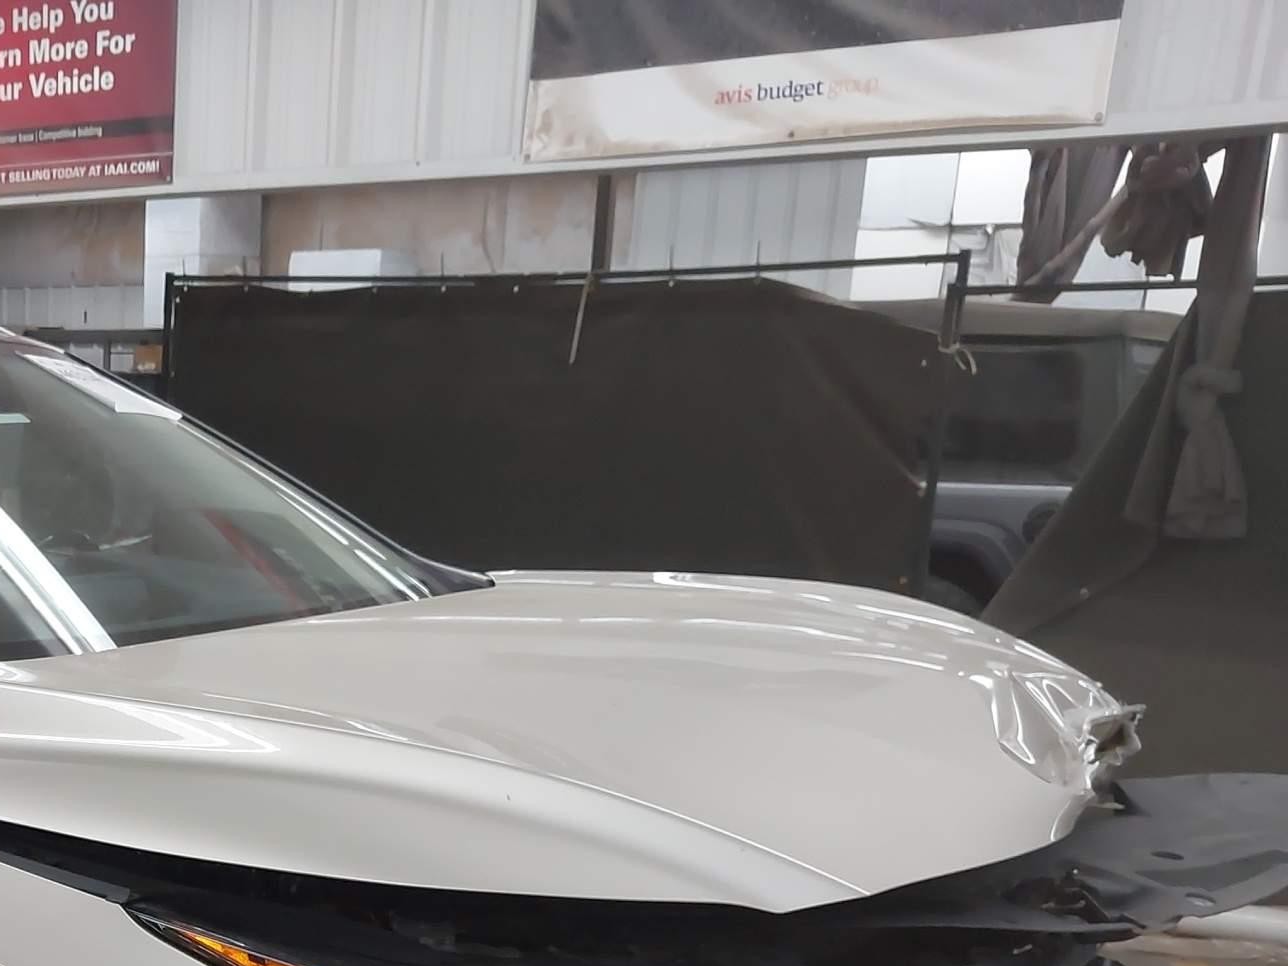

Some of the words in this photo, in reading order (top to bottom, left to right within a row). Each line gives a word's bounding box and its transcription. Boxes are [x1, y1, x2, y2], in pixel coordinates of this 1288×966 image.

[12, 4, 64, 34] Help
[70, 0, 114, 24] You
[29, 38, 89, 65] More
[96, 29, 136, 57] For
[29, 65, 115, 98] Vehicle
[714, 84, 752, 105] avis
[757, 80, 823, 102] budget
[9, 168, 51, 183] SELLING
[52, 166, 86, 180] TODAY
[88, 165, 102, 177] AT
[104, 160, 160, 175] IAAI.COM!
